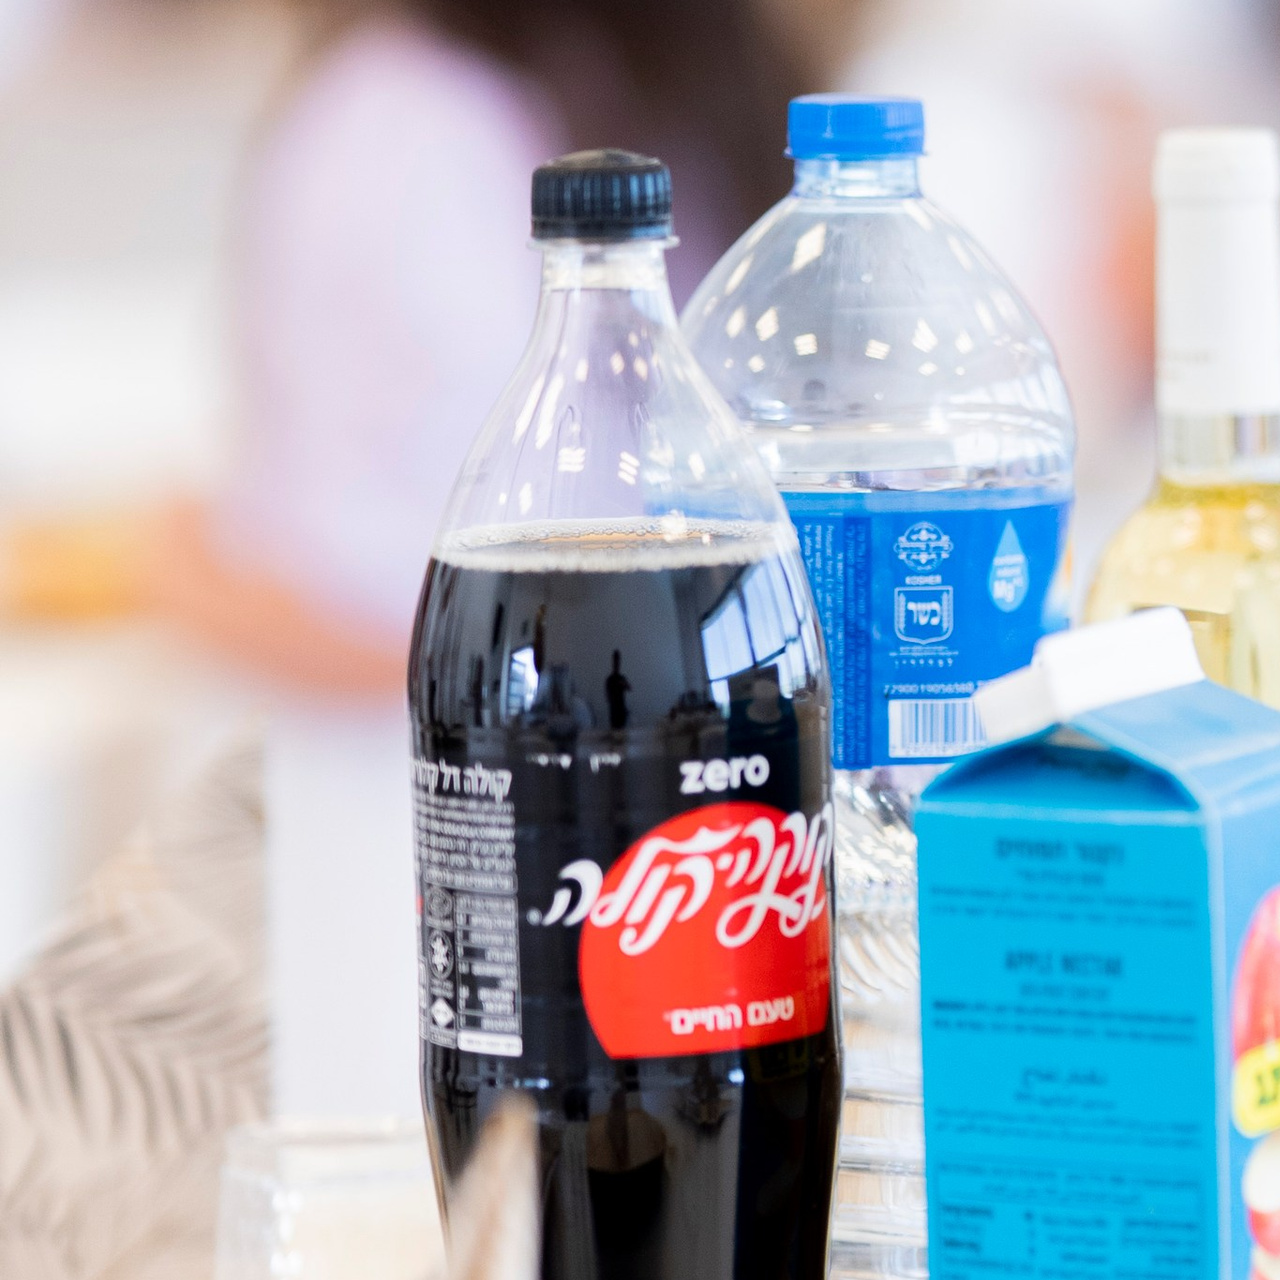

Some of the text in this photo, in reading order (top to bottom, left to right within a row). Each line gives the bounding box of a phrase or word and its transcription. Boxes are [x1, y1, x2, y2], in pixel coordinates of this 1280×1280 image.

[907, 600, 941, 627] כשר
[680, 754, 770, 795] zero
[670, 995, 795, 1036] טעם החיים
